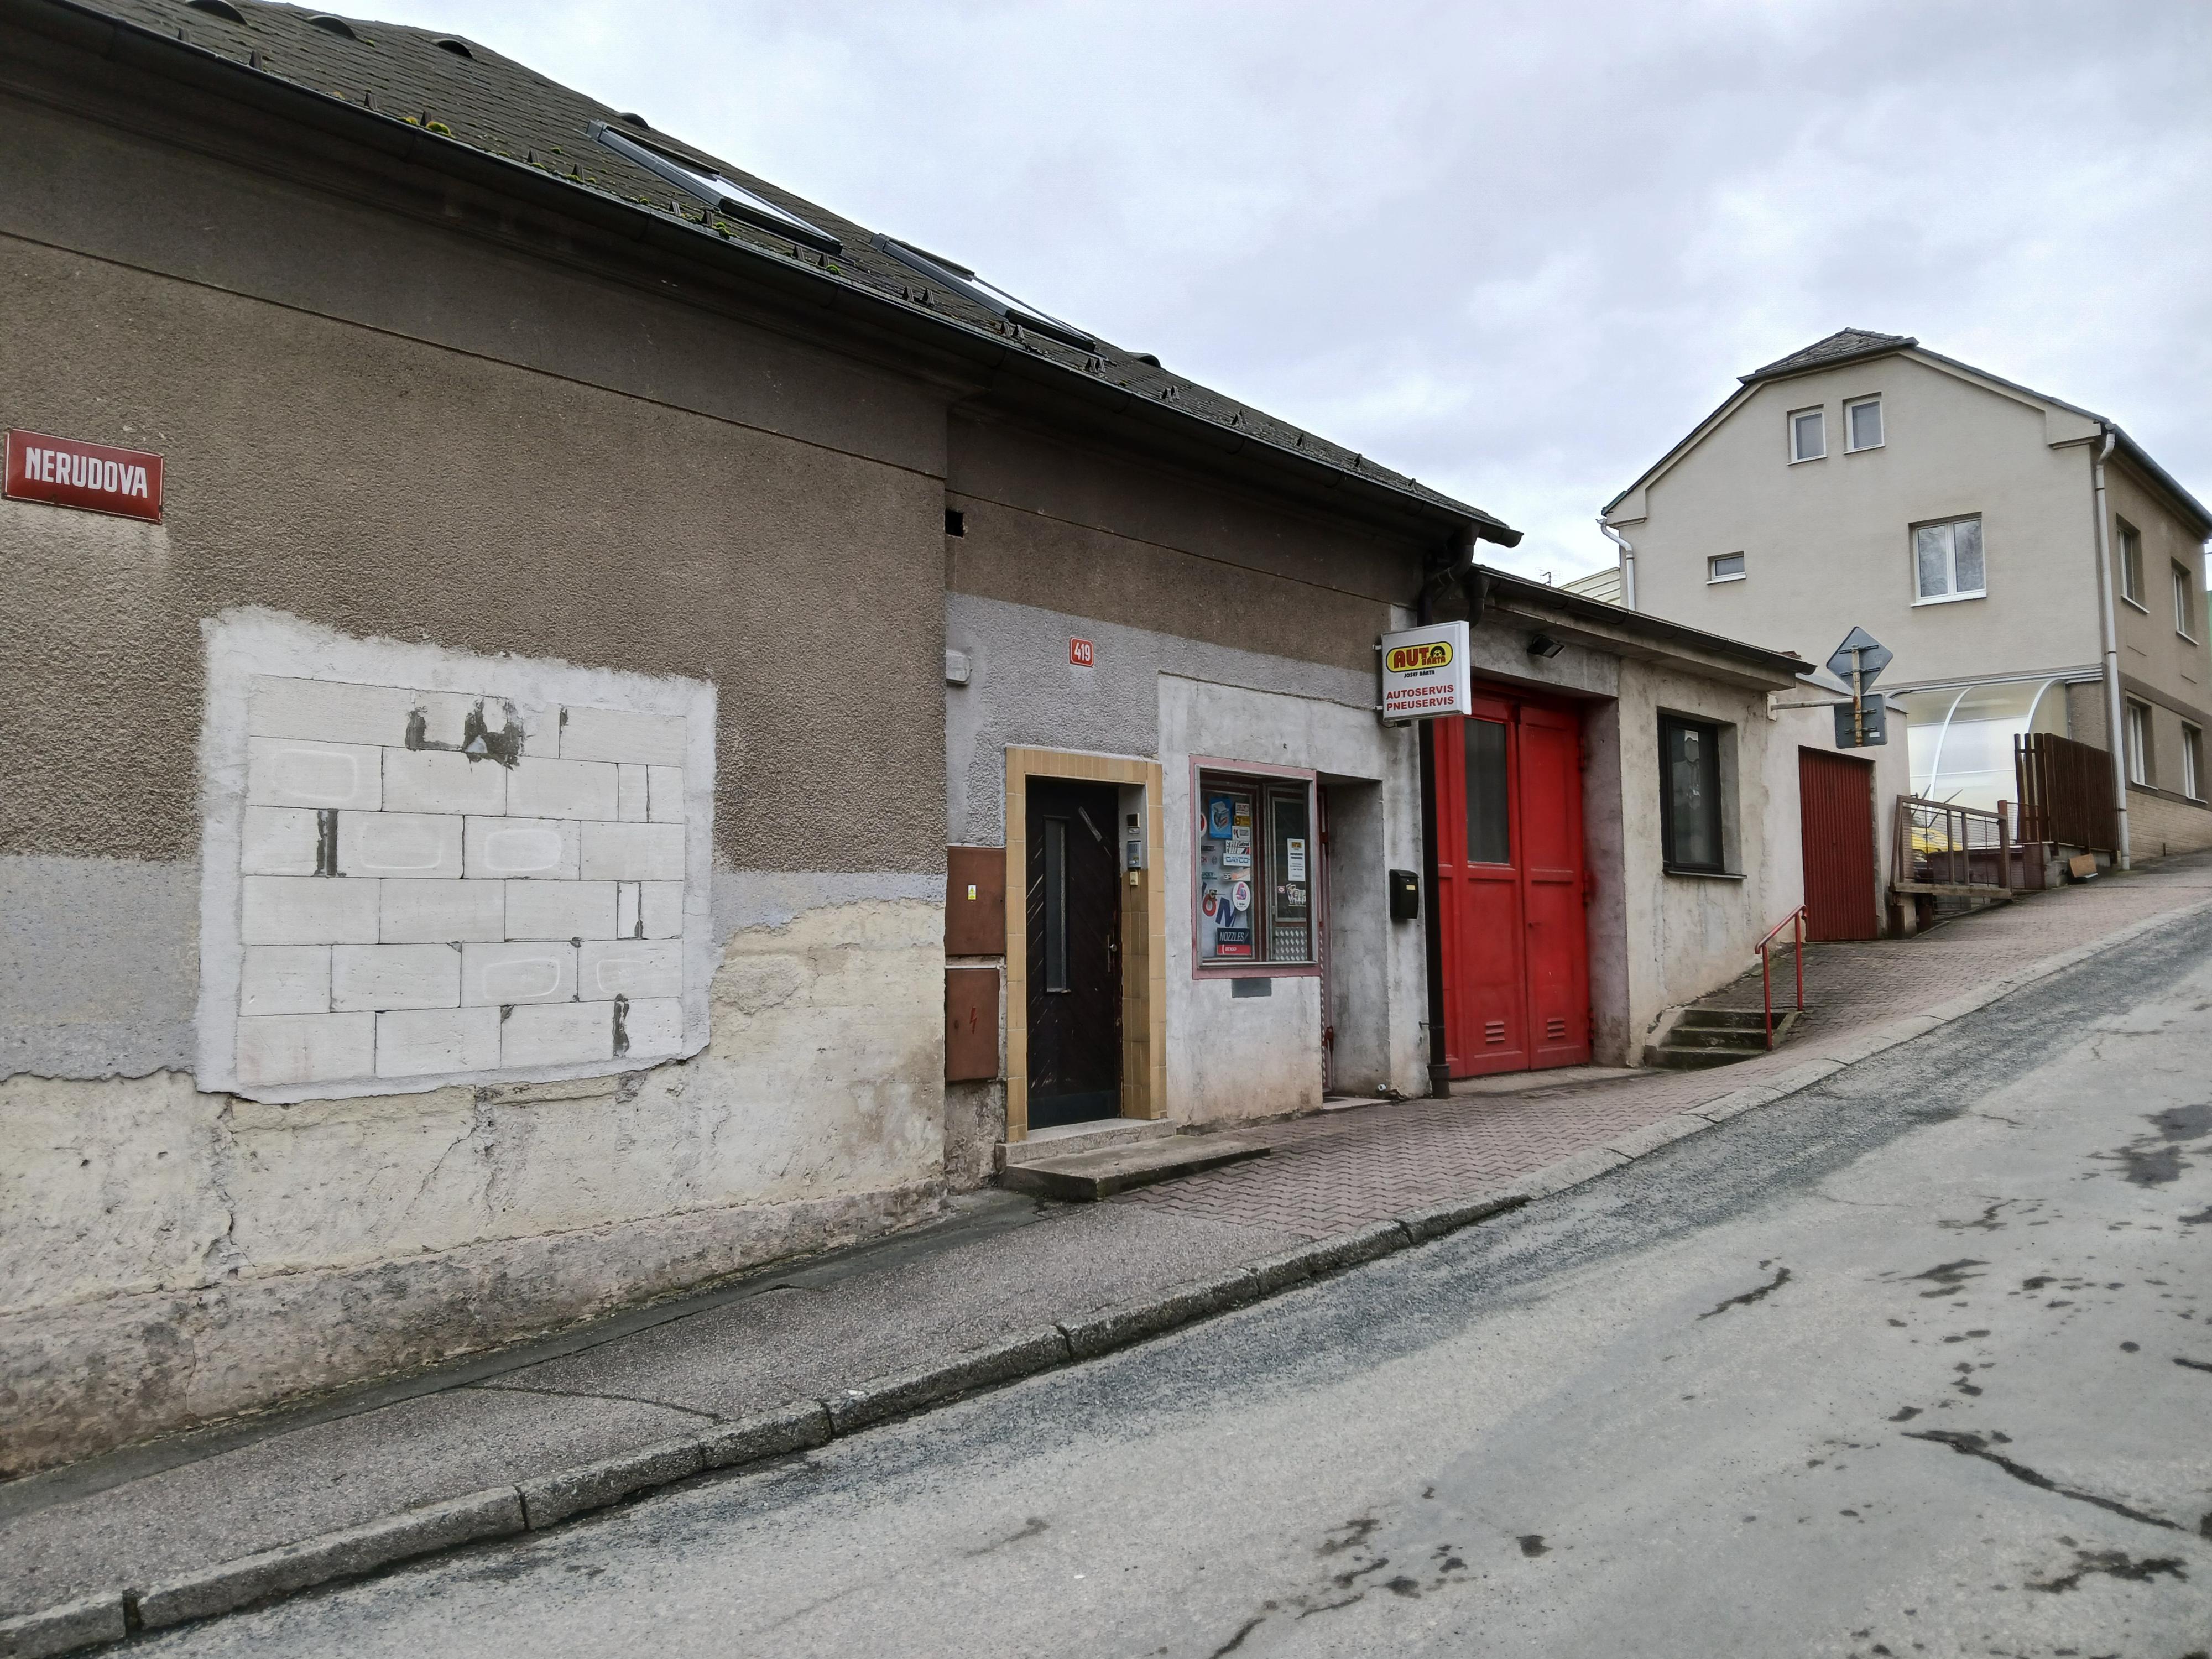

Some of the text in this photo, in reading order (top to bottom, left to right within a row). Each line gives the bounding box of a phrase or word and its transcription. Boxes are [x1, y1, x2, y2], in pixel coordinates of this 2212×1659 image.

[25, 447, 148, 498] NERUDOVA
[1074, 642, 1091, 661] 419
[1386, 684, 1454, 700] AUTOSERVIS
[1387, 696, 1454, 711] PNEUSERVIS
[1219, 931, 1244, 942] NOZZLES
